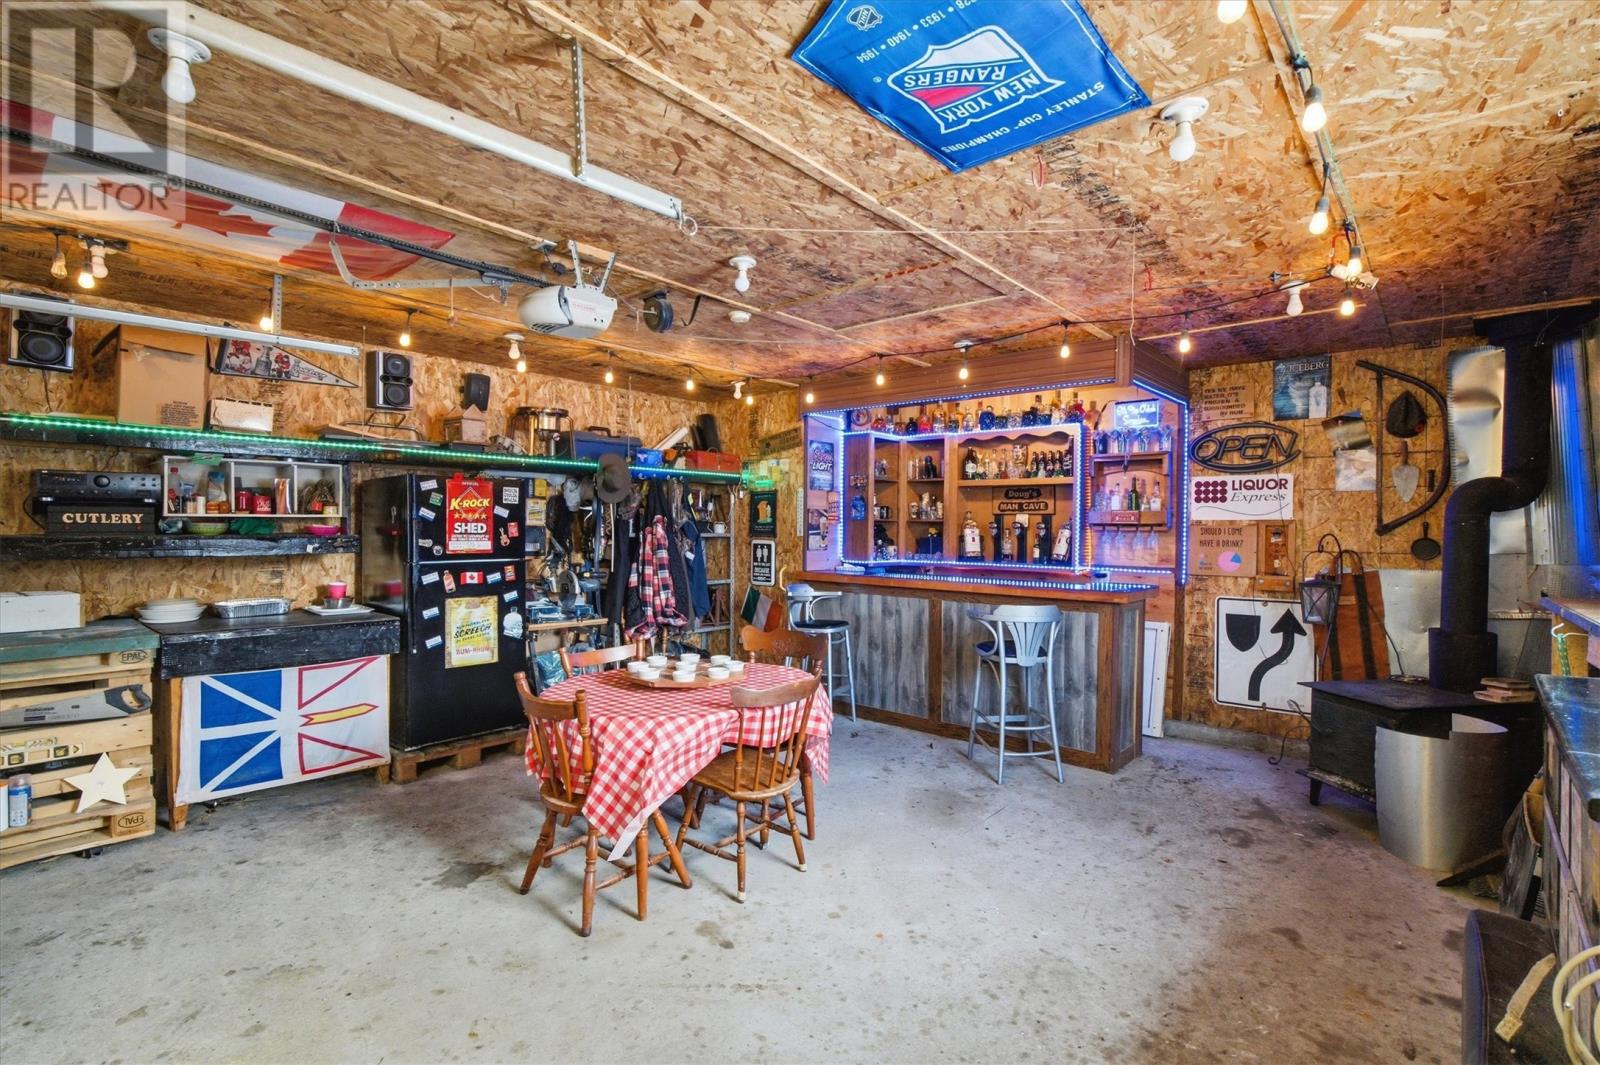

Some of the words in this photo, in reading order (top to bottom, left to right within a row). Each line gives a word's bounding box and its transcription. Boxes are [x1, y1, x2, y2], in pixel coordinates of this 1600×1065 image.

[920, 10, 946, 28] 1933
[886, 29, 911, 47] 1940
[856, 47, 880, 63] 1994
[904, 65, 1006, 87] RANGERS
[994, 72, 1041, 103] NEW
[1046, 81, 1105, 116] STANLEY
[938, 101, 993, 123] YORK
[941, 127, 1010, 153] CHAMPIONS
[1194, 433, 1297, 460] OPEN
[812, 462, 833, 471] LIGHT
[1231, 478, 1288, 491] LIQUOR
[1008, 489, 1038, 499] Doug's
[1230, 492, 1287, 504] Express
[449, 497, 491, 511] K-ROCK
[1022, 502, 1046, 510] CAVE
[62, 513, 144, 524] CUTLERY
[453, 522, 487, 534] SHED
[1200, 527, 1221, 536] SHOULD
[1228, 527, 1242, 536] COME
[1199, 539, 1214, 548] HAVE
[1222, 539, 1244, 548] DRINK?
[454, 622, 492, 639] SCREECH
[125, 814, 144, 826] EPAL
